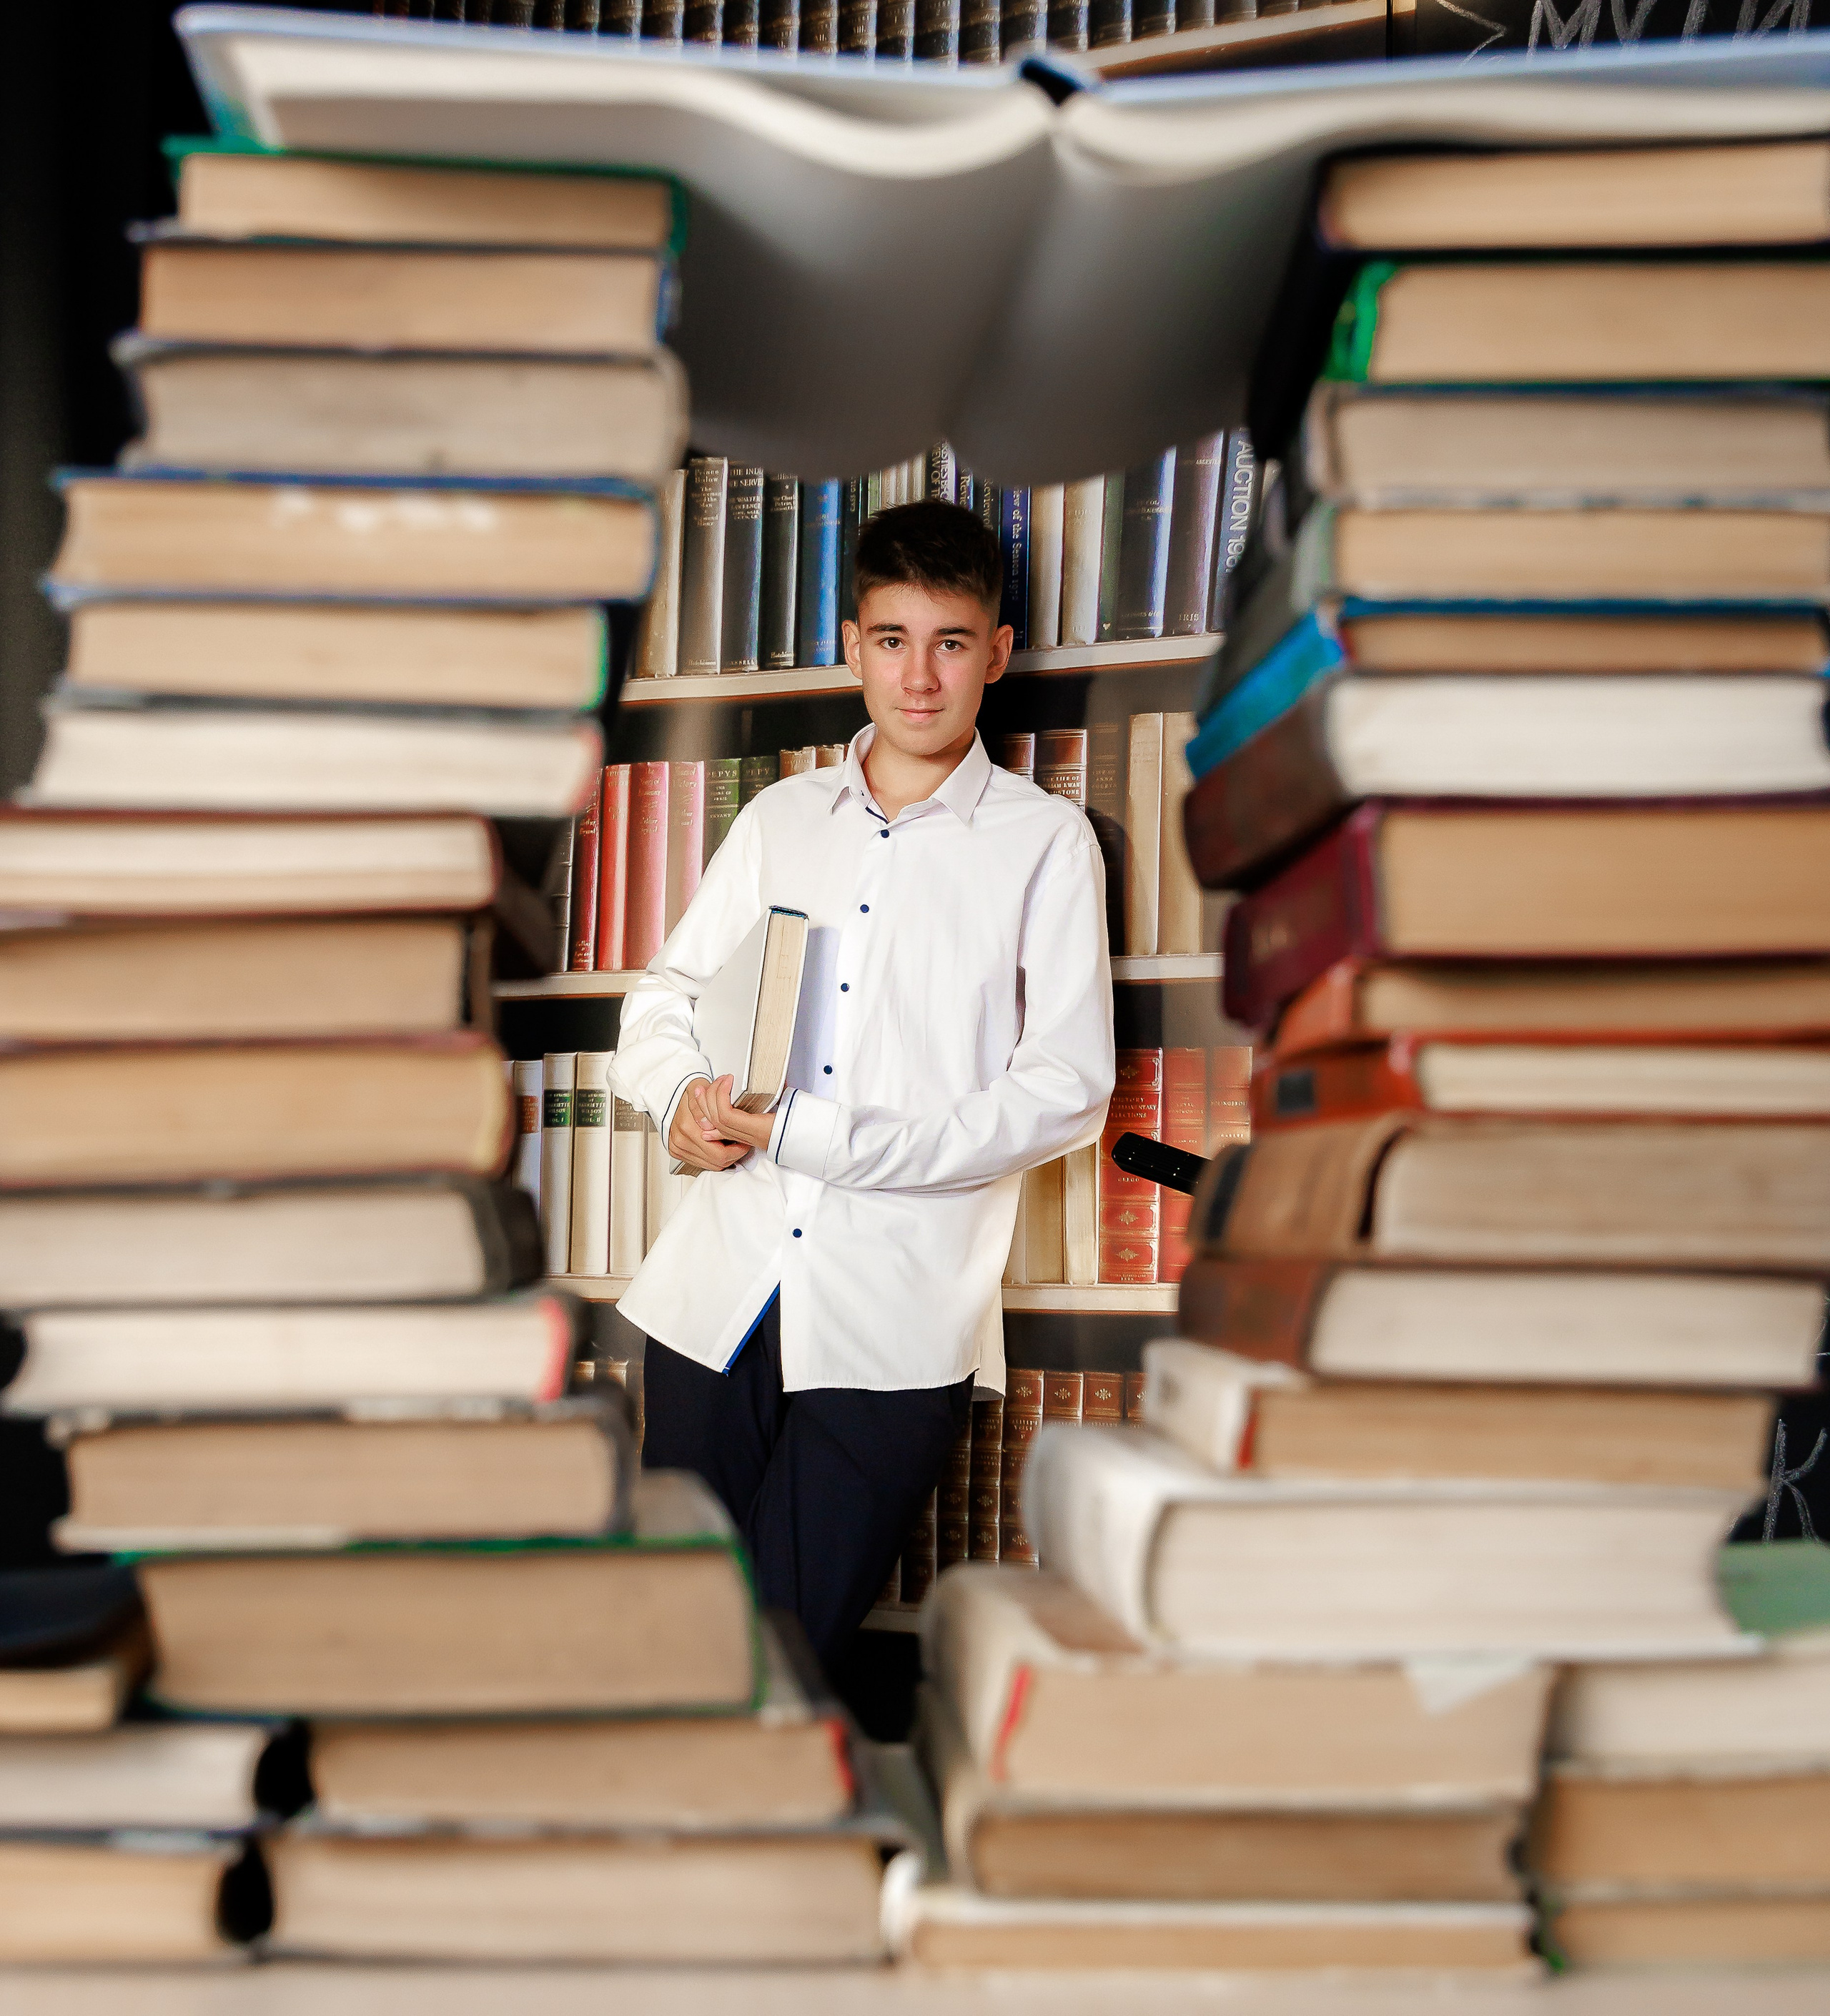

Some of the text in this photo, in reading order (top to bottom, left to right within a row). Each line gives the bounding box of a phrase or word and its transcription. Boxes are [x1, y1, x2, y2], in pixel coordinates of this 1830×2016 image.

[1229, 440, 1254, 531] AUCTION
[1012, 509, 1023, 522] of
[1012, 523, 1023, 539] the
[1012, 543, 1023, 575] Season
